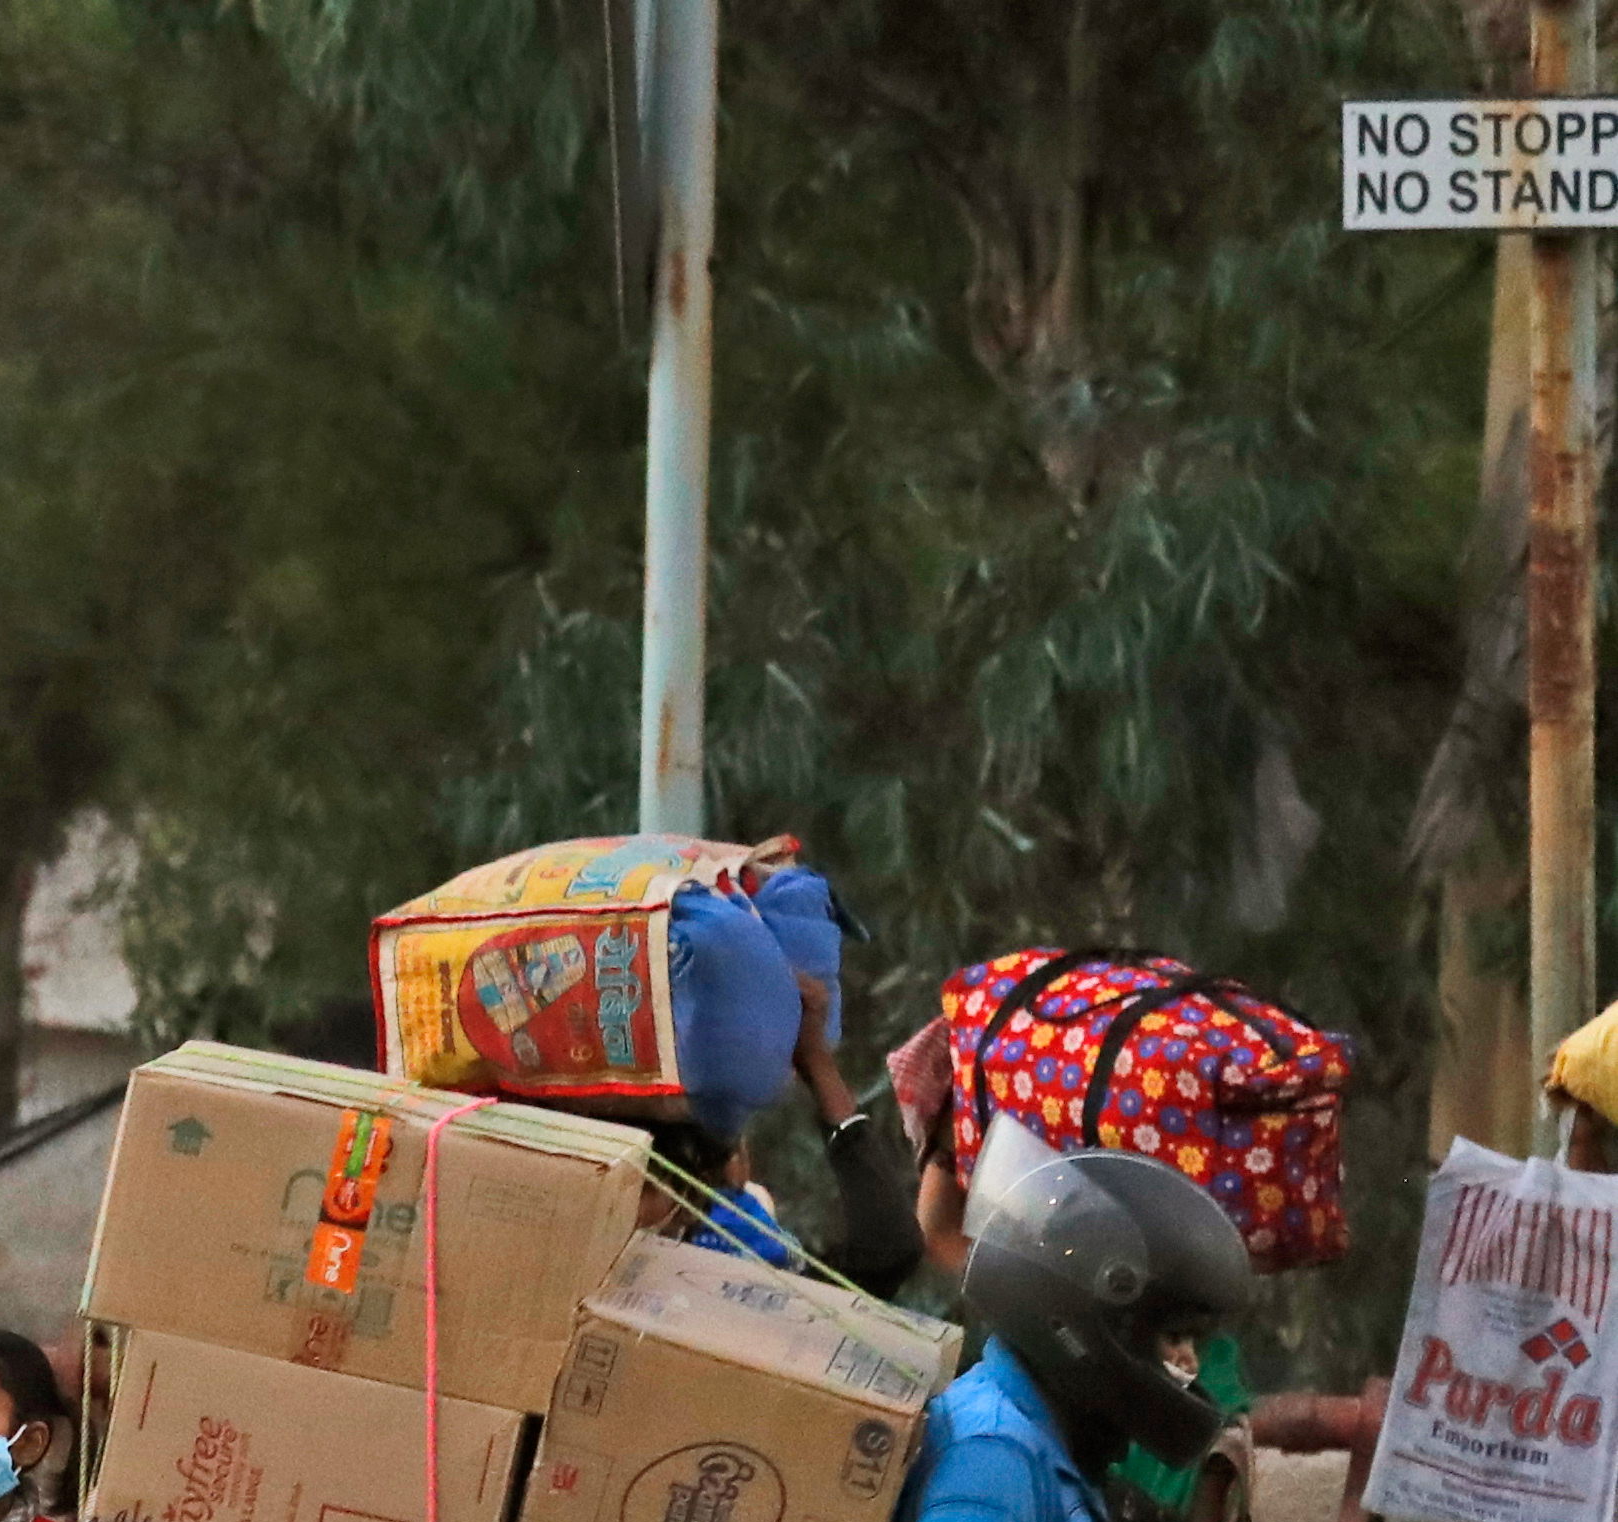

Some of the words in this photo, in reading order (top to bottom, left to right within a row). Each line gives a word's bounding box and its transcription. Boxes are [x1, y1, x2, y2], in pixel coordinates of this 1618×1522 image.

[1358, 113, 1430, 156] NO
[1449, 113, 1618, 156] STOPP
[1358, 170, 1430, 214] NO
[1449, 170, 1618, 213] STAND
[209, 1427, 239, 1504] secure
[1431, 1420, 1549, 1466] Emporium
[244, 1467, 265, 1515] LARGE
